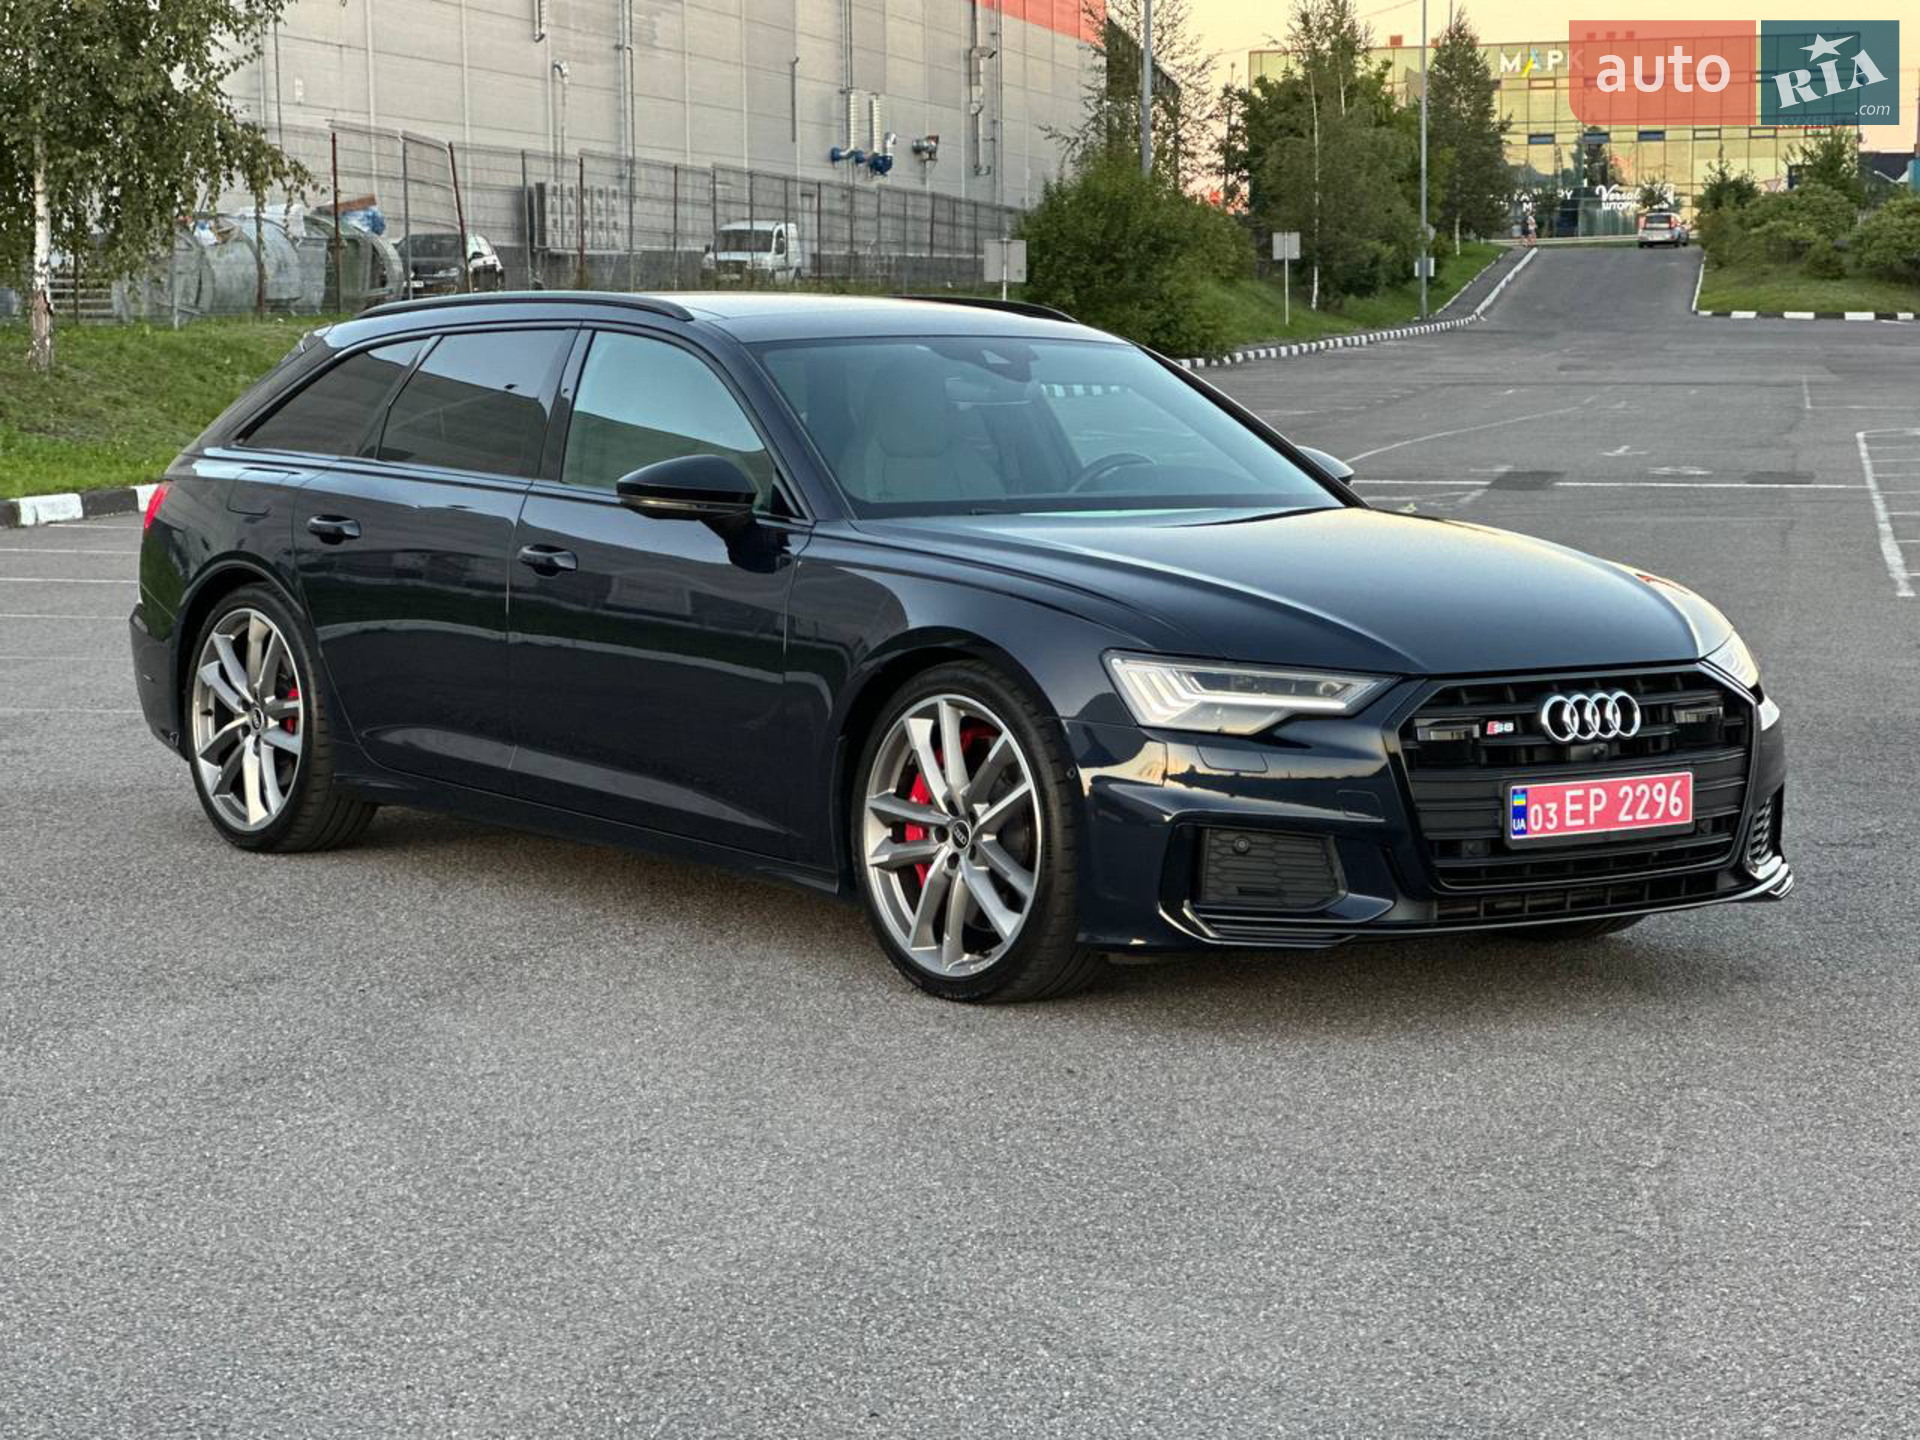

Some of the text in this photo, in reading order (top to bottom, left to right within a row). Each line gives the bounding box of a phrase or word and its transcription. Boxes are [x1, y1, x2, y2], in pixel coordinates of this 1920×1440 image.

[1529, 780, 1683, 831] 03 EP 2296
[1512, 818, 1527, 831] UA
